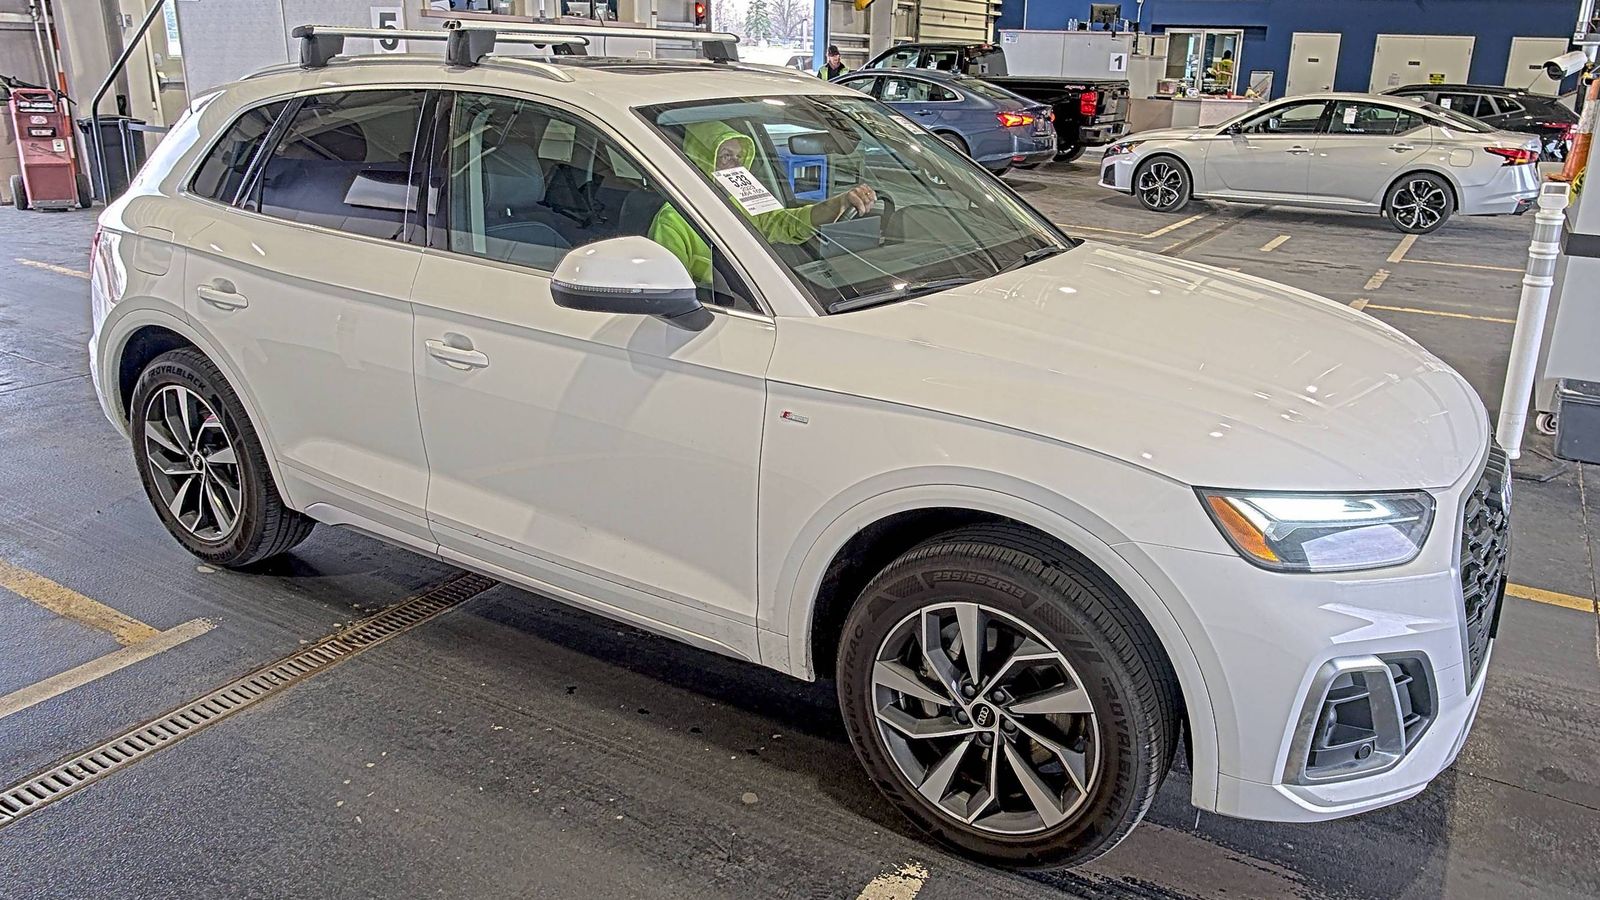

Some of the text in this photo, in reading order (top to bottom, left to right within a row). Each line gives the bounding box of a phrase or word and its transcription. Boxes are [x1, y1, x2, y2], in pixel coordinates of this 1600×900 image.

[379, 12, 399, 51] 5
[1114, 55, 1123, 70] 1
[728, 174, 752, 188] 5:33
[148, 365, 206, 391] ROYALBLACK
[1102, 677, 1132, 821] ROYALBLACK
